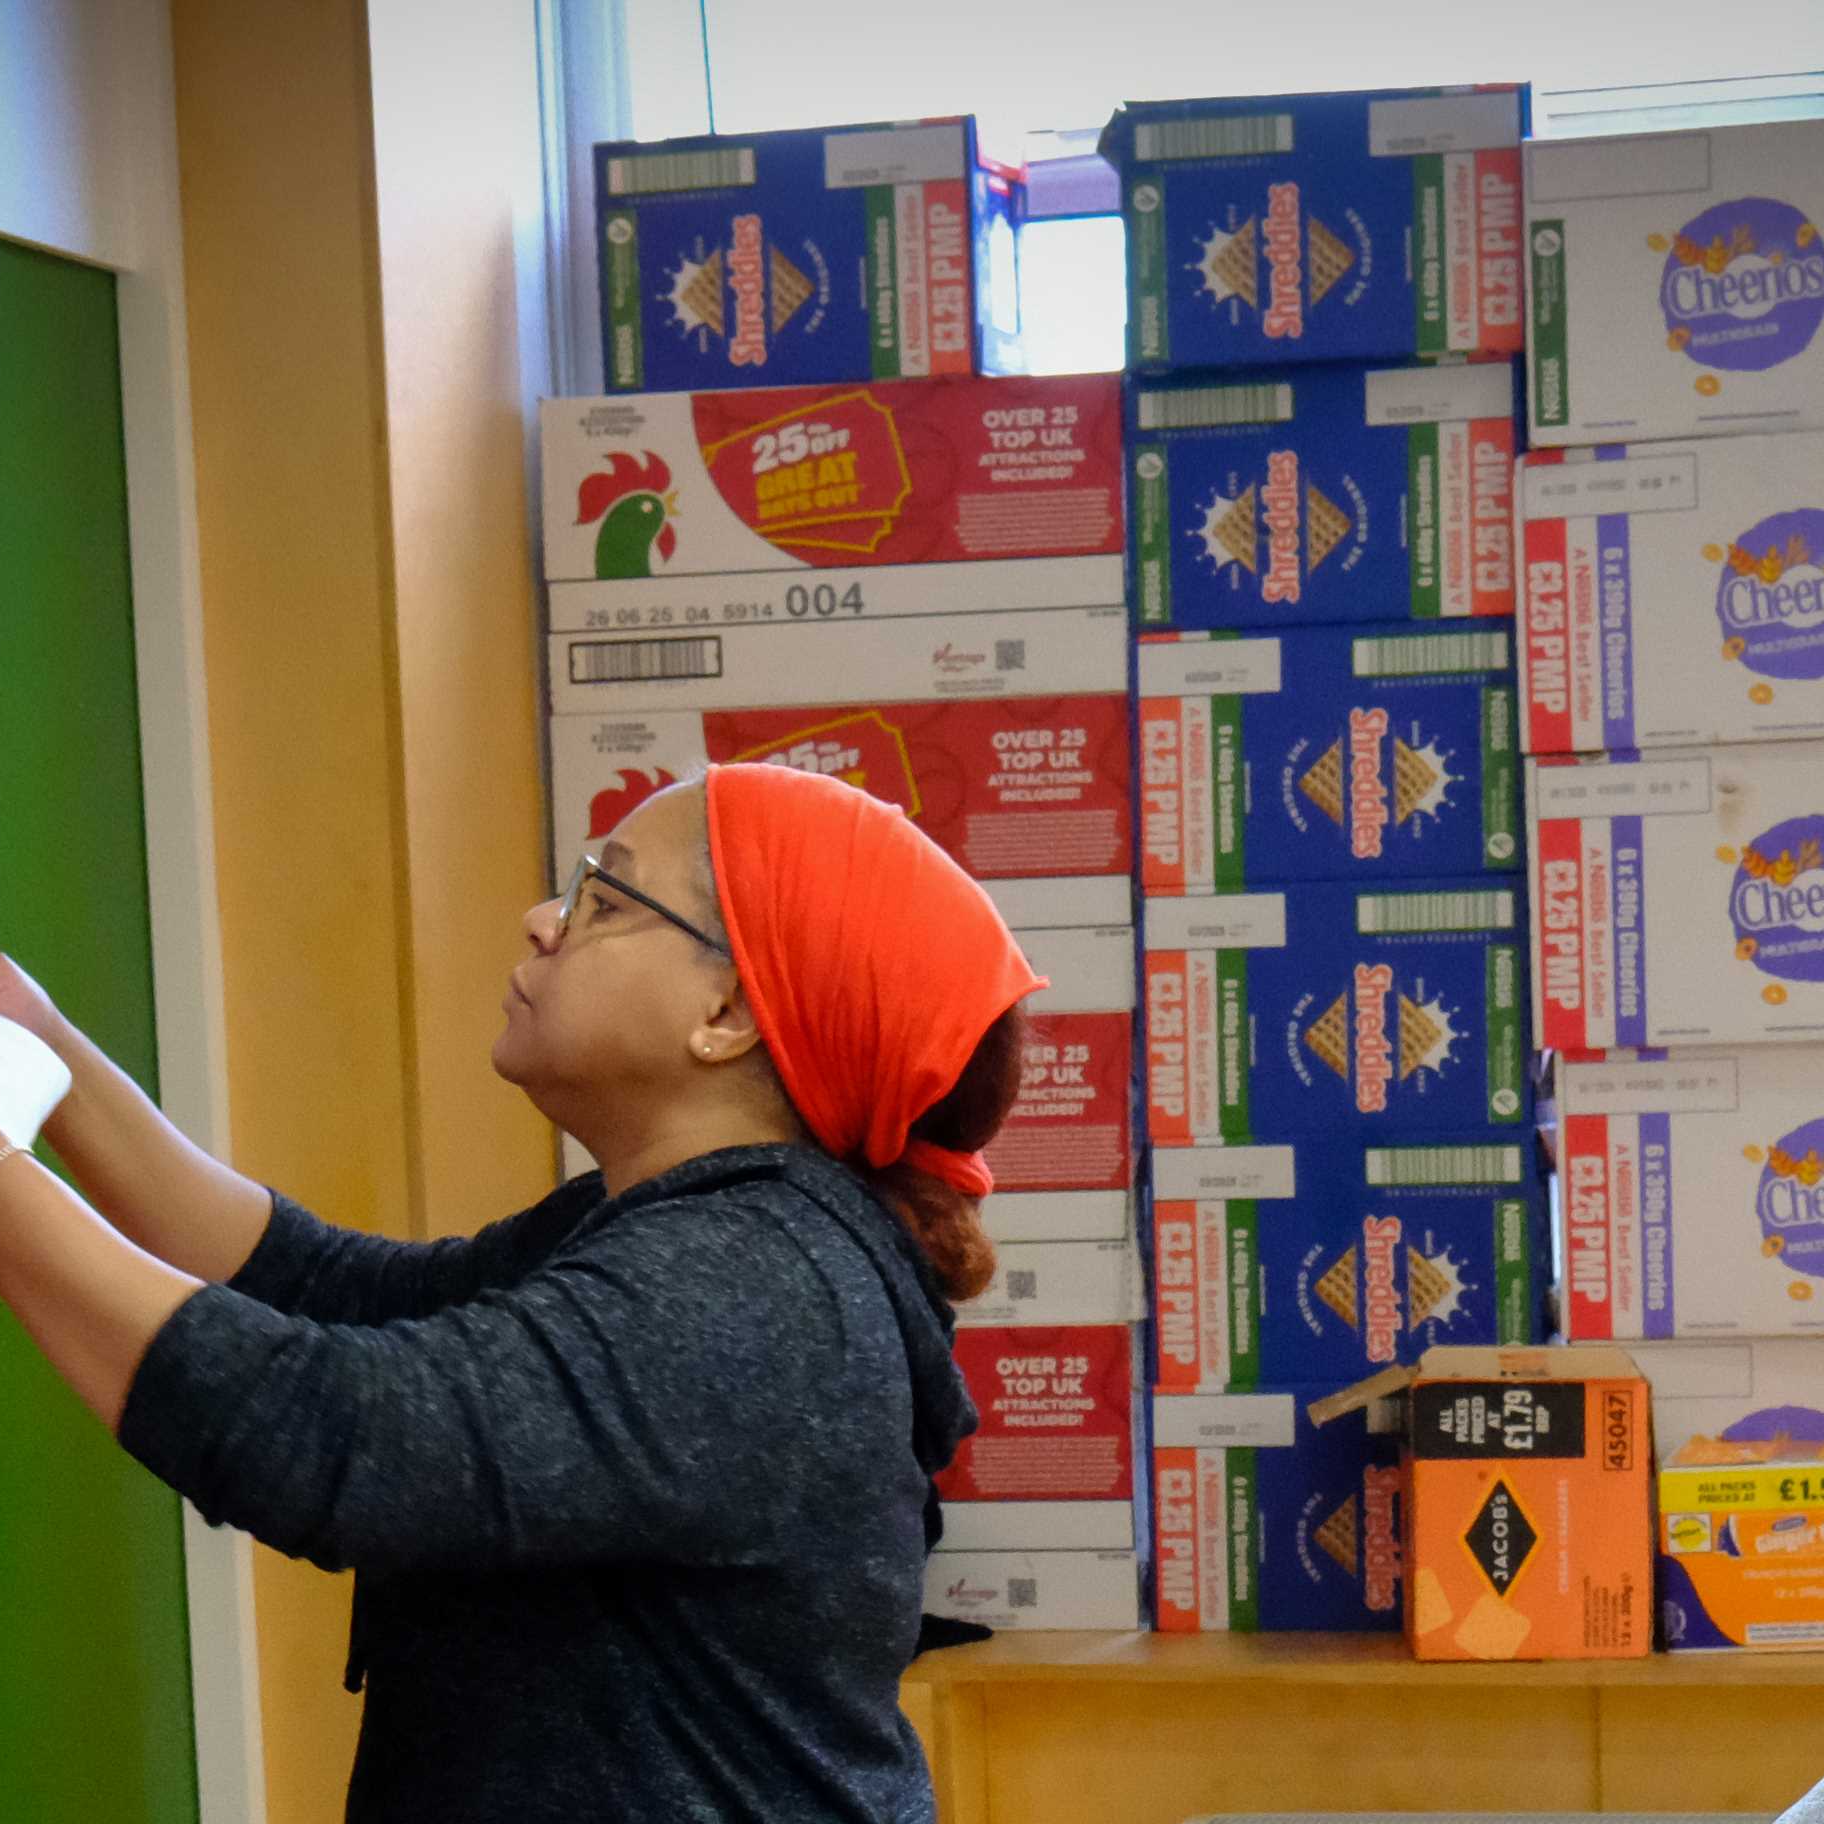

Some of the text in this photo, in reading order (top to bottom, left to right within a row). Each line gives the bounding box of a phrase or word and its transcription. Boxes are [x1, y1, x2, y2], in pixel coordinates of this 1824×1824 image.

[1480, 172, 1517, 255] PMP
[729, 213, 767, 366] Shreddies
[1263, 182, 1303, 339] Shreddies
[754, 424, 808, 473] 25
[981, 406, 1079, 429] OVER 25
[988, 429, 1074, 449] TOP UK
[755, 450, 858, 500] GREAT
[1261, 450, 1302, 604] Shreddies
[784, 581, 865, 618] 004
[1529, 635, 1568, 713] PMP
[1349, 708, 1388, 859] Shreddies
[1142, 789, 1180, 865] PMP
[1545, 932, 1581, 1010] PMP
[1354, 963, 1393, 1113] Shreddies
[1570, 1157, 1608, 1304] £3.25 PMP
[1363, 1215, 1402, 1363] Shreddies
[1161, 1290, 1197, 1365] PMP
[1440, 1408, 1454, 1434] ALL
[1455, 1398, 1469, 1443] PACKS
[1471, 1396, 1485, 1444] PRICED
[1487, 1411, 1501, 1429] AT
[1503, 1390, 1533, 1450] £1.79
[1607, 1395, 1628, 1468] 45047
[1364, 1464, 1401, 1612] Shreddies
